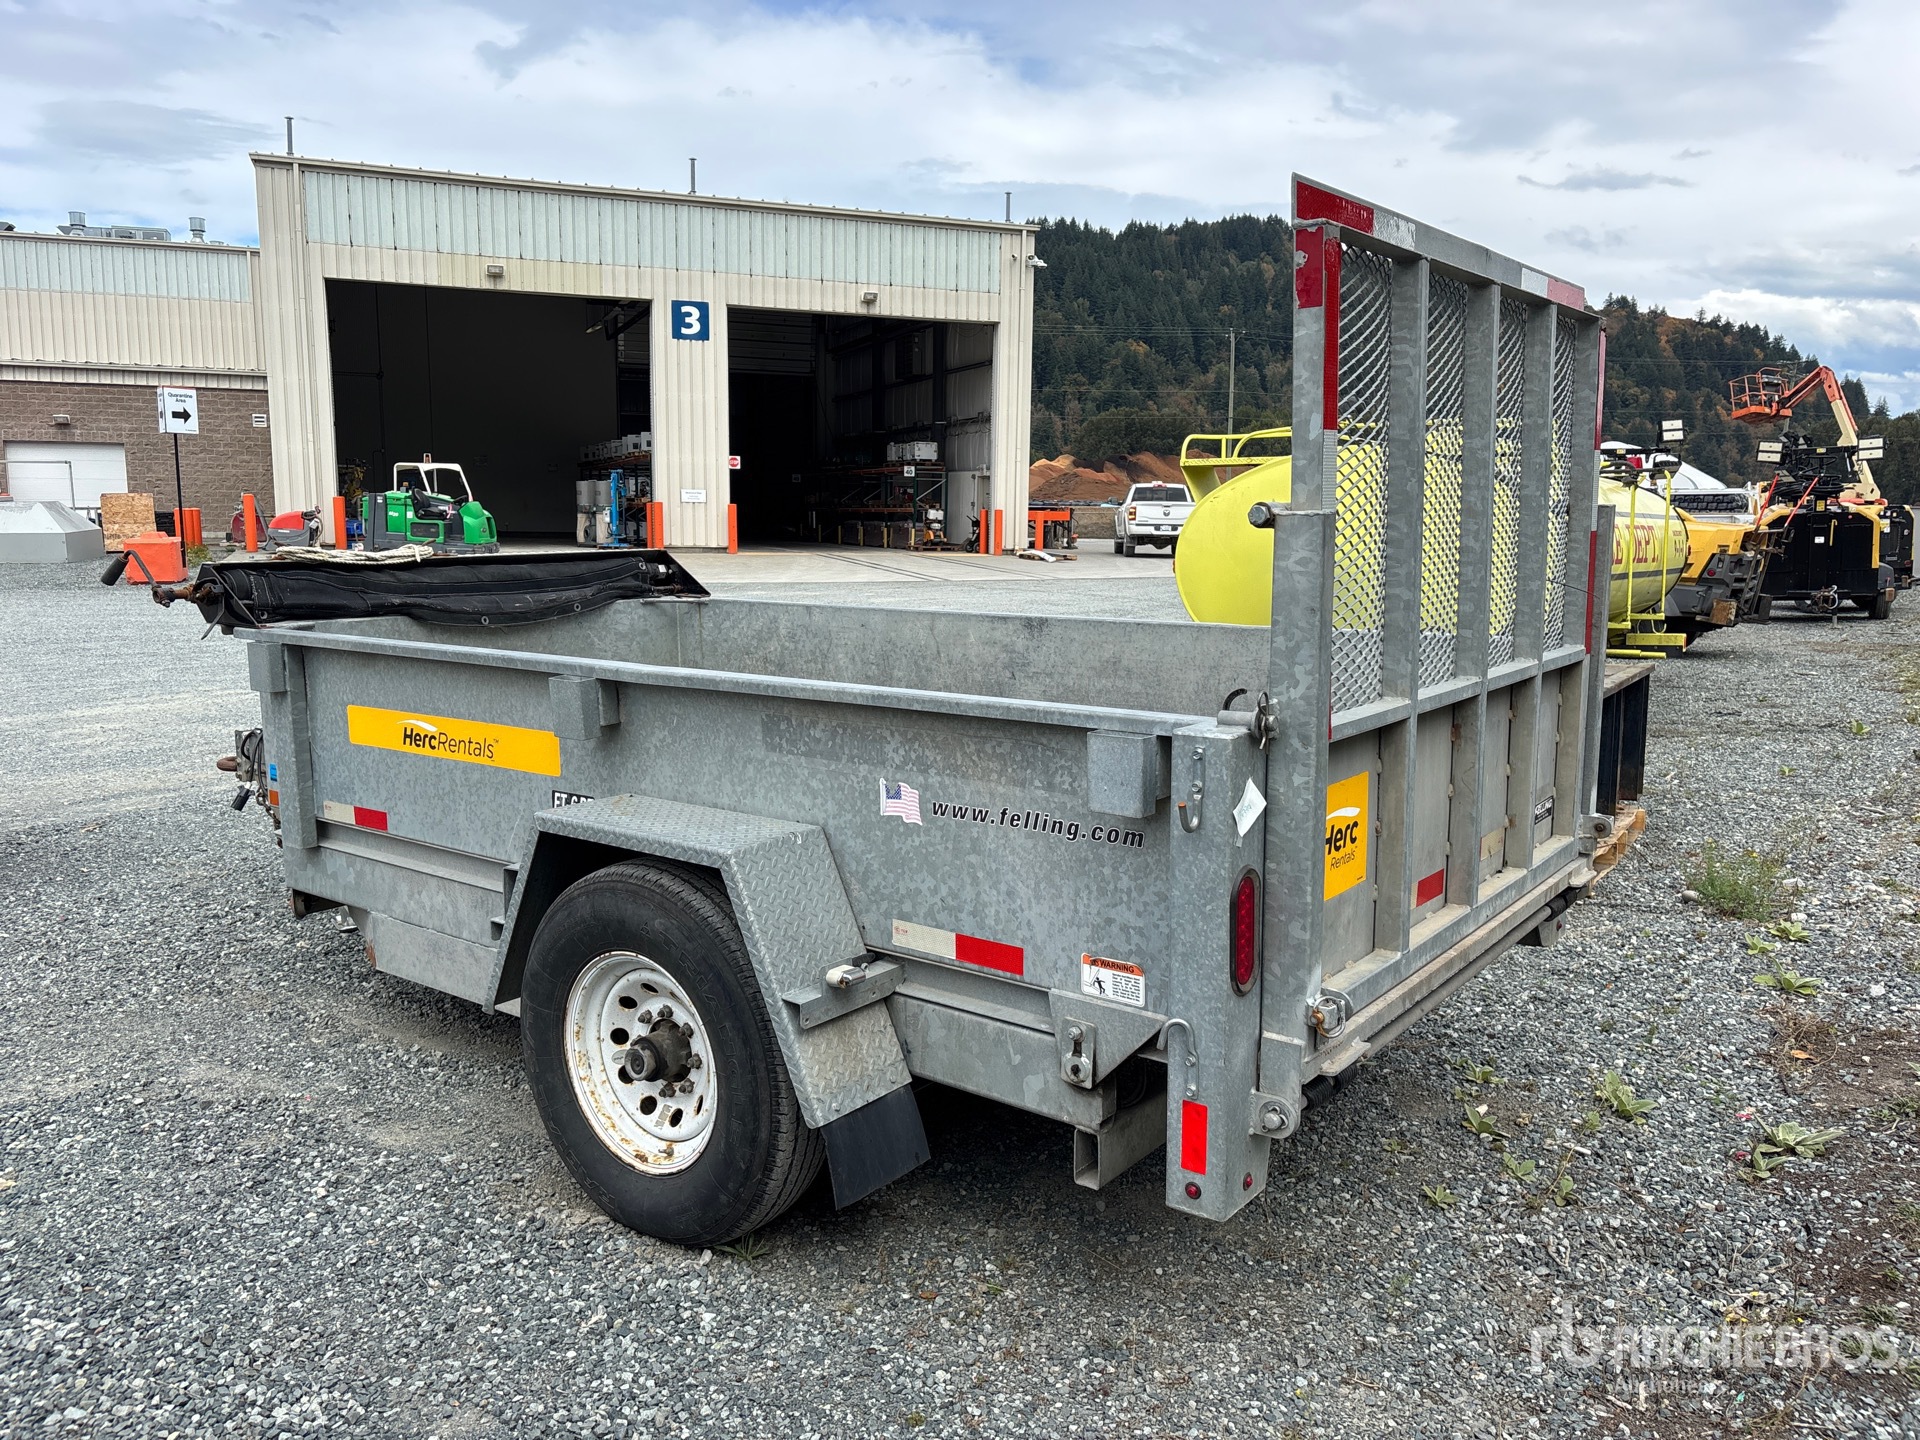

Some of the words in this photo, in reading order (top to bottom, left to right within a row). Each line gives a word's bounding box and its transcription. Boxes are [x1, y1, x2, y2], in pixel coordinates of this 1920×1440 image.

[680, 305, 701, 335] 3
[932, 800, 1144, 848] www.felling.com
[1326, 820, 1359, 855] Herc
[1330, 849, 1356, 871] Rentals
[1100, 960, 1134, 973] WARNING
